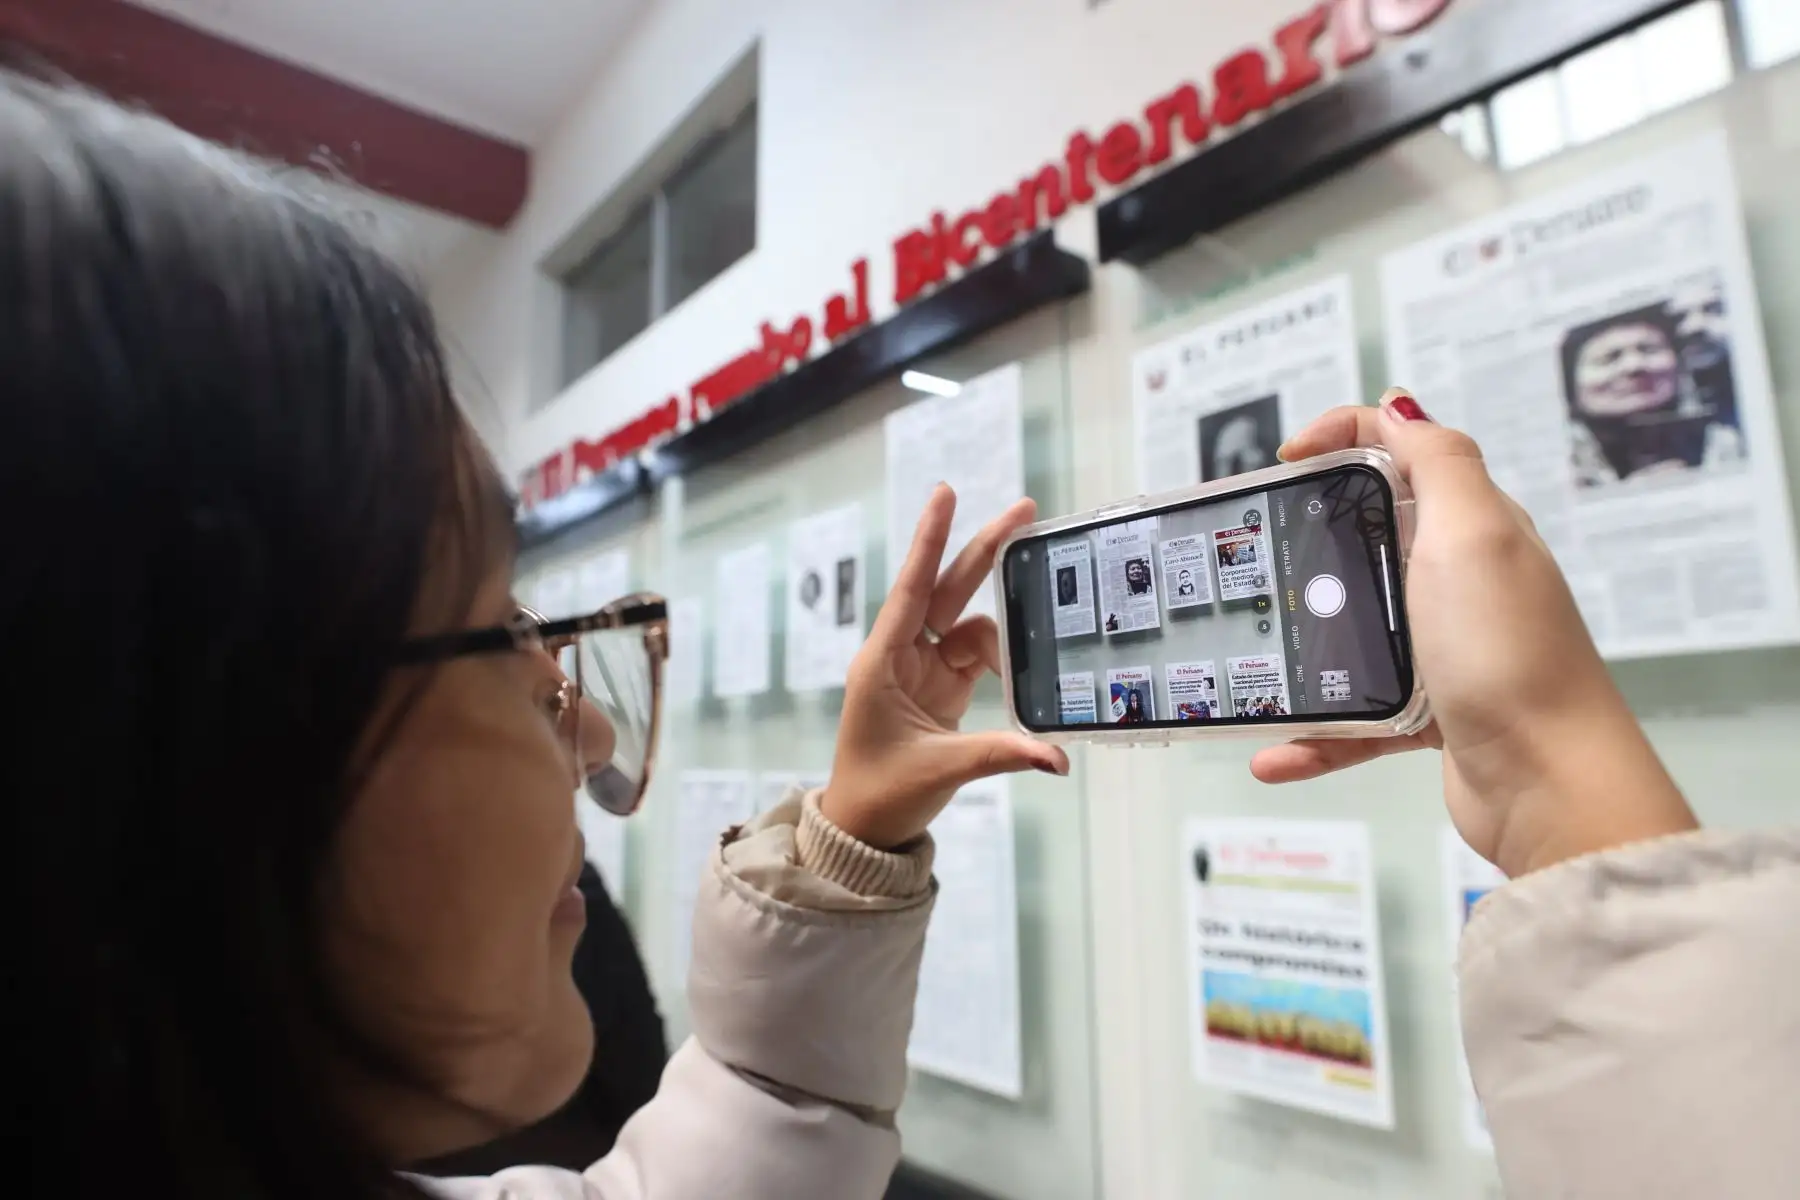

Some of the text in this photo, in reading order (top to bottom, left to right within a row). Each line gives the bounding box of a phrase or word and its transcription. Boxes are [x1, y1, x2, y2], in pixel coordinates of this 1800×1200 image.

[823, 258, 872, 340] al
[1283, 540, 1292, 575] RETRATO
[1221, 566, 1258, 578] Corporación
[1232, 573, 1254, 581] medios
[1234, 579, 1256, 587] Estado
[1288, 590, 1296, 611] FOTO
[1292, 625, 1300, 650] VIDEO
[1246, 661, 1269, 669] Peruano
[1122, 672, 1142, 680] Peruano
[1296, 664, 1304, 683] CINE
